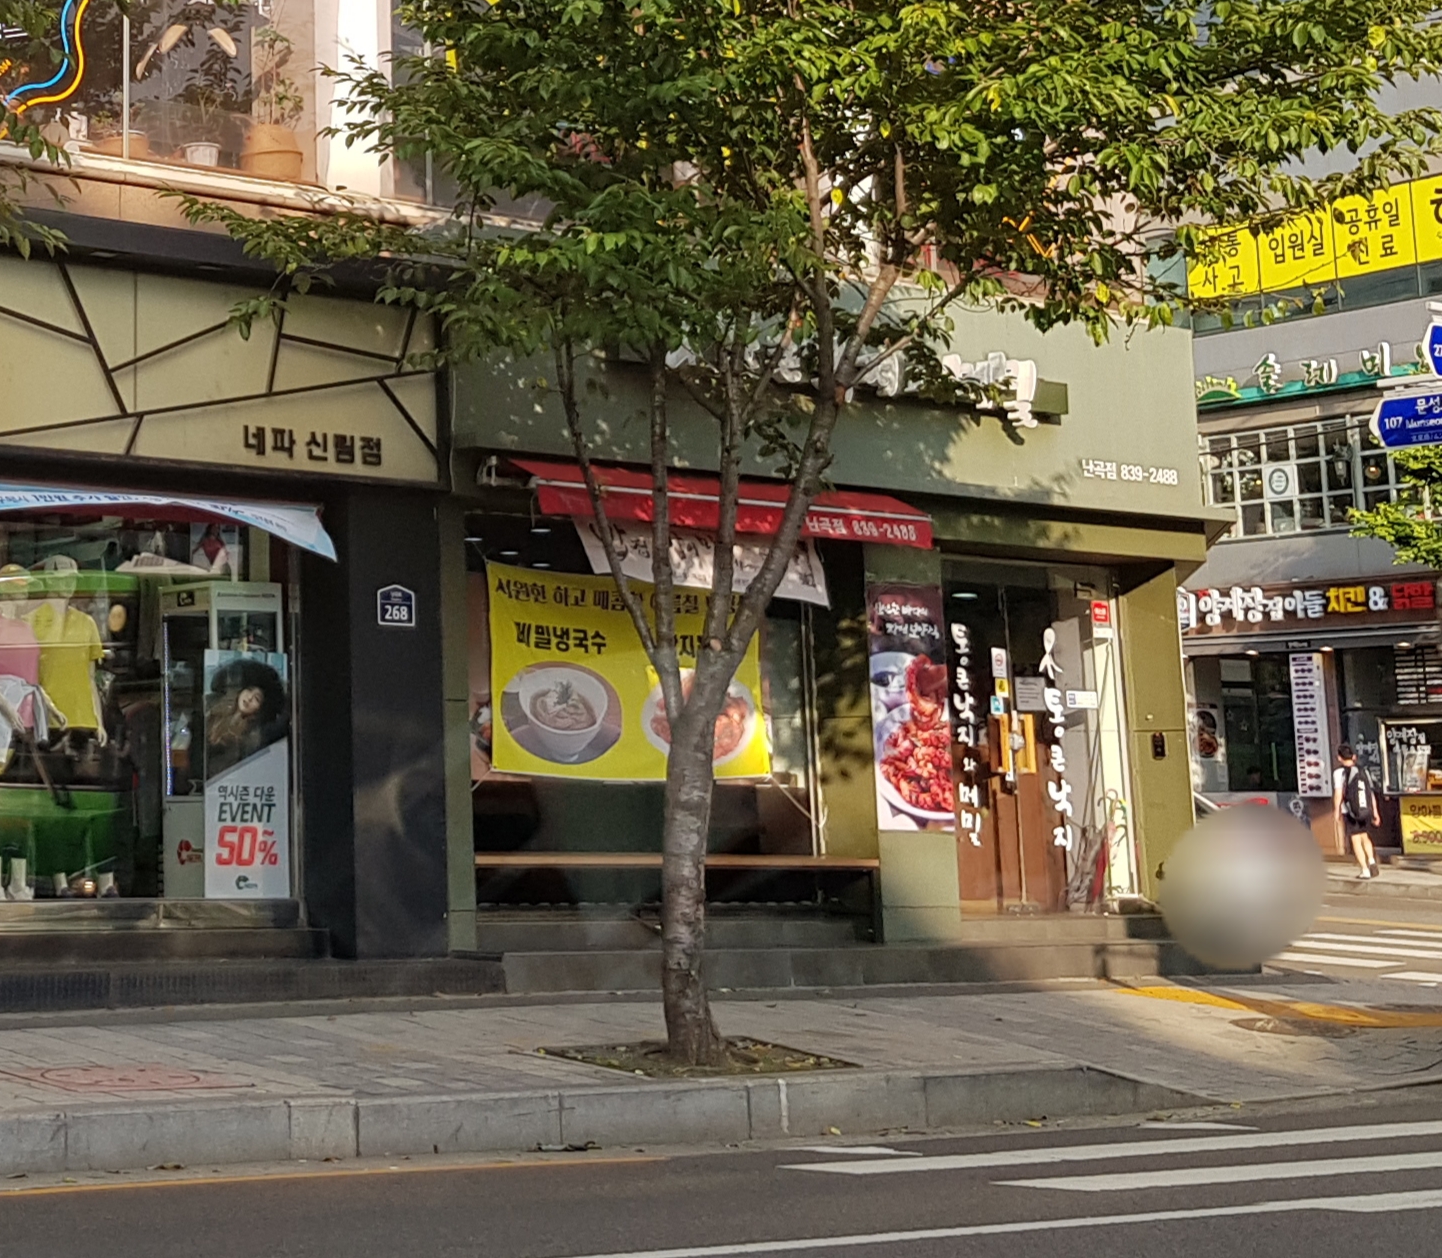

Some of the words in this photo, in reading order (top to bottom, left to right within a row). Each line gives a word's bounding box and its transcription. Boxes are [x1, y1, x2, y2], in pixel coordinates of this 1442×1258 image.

[1343, 198, 1401, 237] 공휴일
[1268, 229, 1325, 265] 입원실
[1384, 417, 1403, 430] 107
[243, 425, 296, 460] 네파
[306, 431, 382, 467] 신림점
[1082, 458, 1117, 480] 난곡점
[1120, 464, 1179, 486] 839-2488
[805, 515, 848, 535] 난곡점
[852, 519, 918, 541] 839-2488
[1368, 586, 1389, 611] &
[384, 605, 408, 620] 268
[218, 785, 250, 802] 역시즌
[253, 785, 276, 802] 다운
[217, 802, 277, 823] EVENT
